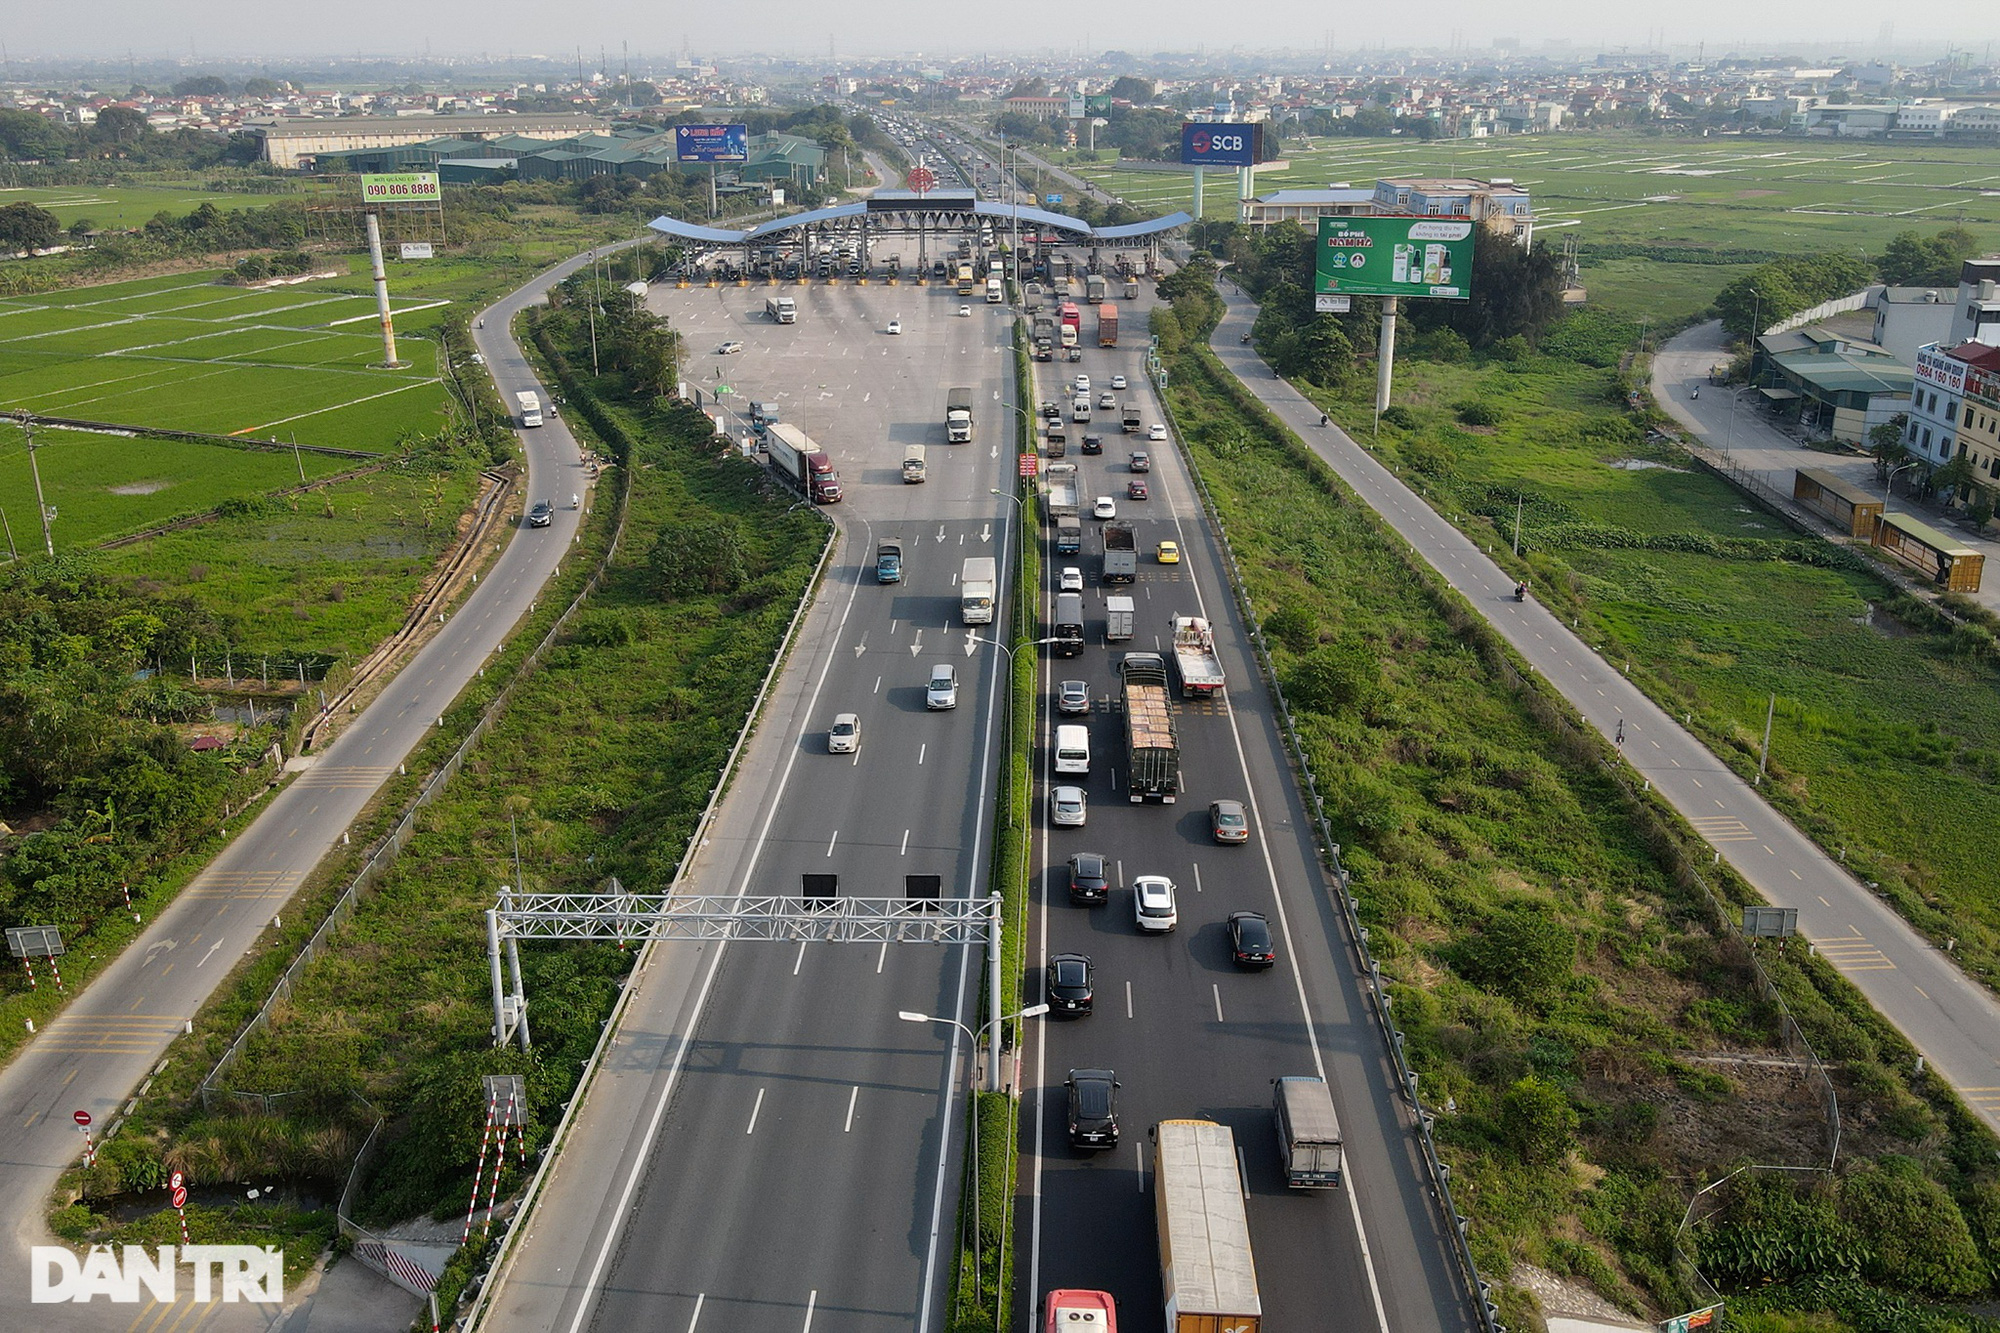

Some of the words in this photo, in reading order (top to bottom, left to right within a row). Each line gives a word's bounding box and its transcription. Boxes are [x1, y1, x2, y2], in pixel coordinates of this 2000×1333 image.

[1212, 135, 1242, 151] SCB
[368, 185, 386, 195] 090
[389, 184, 408, 194] 806
[411, 184, 436, 194] 8888
[1328, 238, 1354, 247] NAM
[1356, 236, 1373, 247] HÀ
[1935, 370, 1946, 383] 160
[1949, 375, 1961, 388] 160
